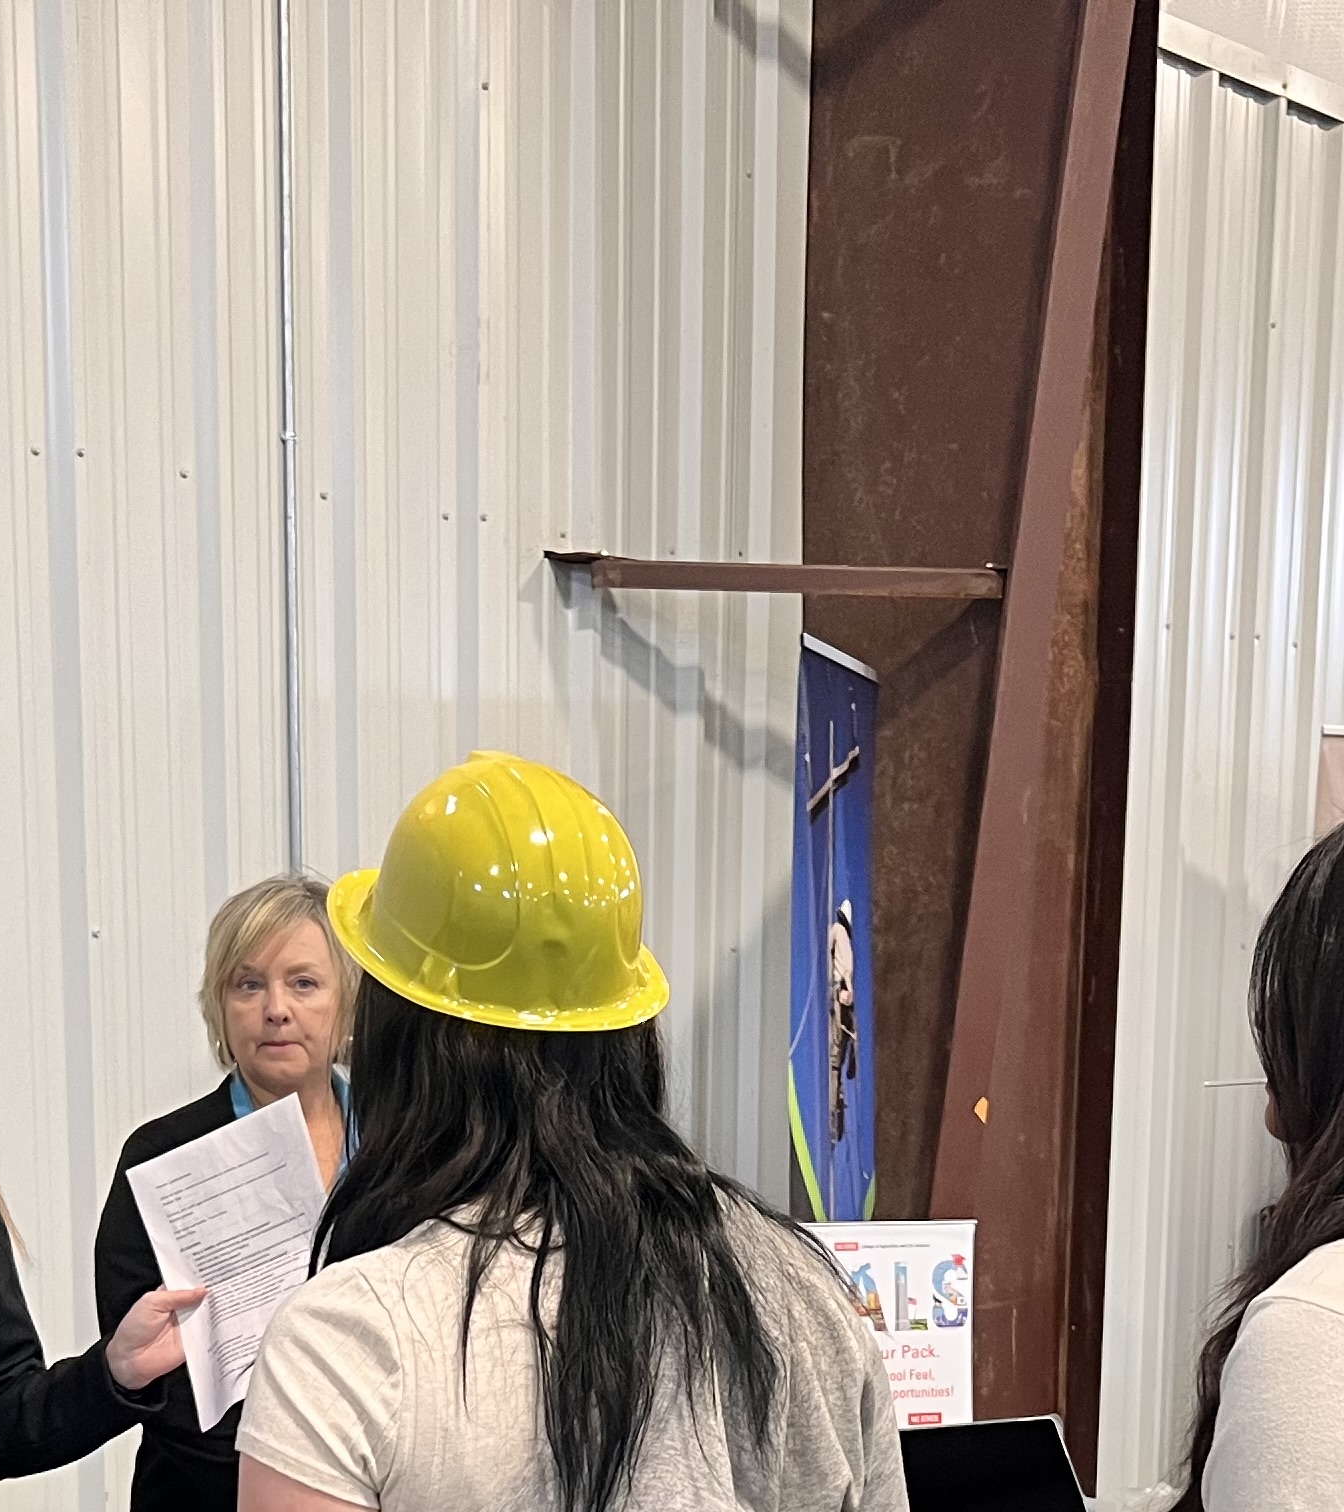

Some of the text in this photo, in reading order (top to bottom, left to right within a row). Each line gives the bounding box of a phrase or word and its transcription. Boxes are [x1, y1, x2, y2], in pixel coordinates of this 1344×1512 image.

[850, 1259, 968, 1331] ALS
[881, 1349, 896, 1360] ur
[889, 1368, 906, 1382] ool
[892, 1385, 954, 1401] portunities!
